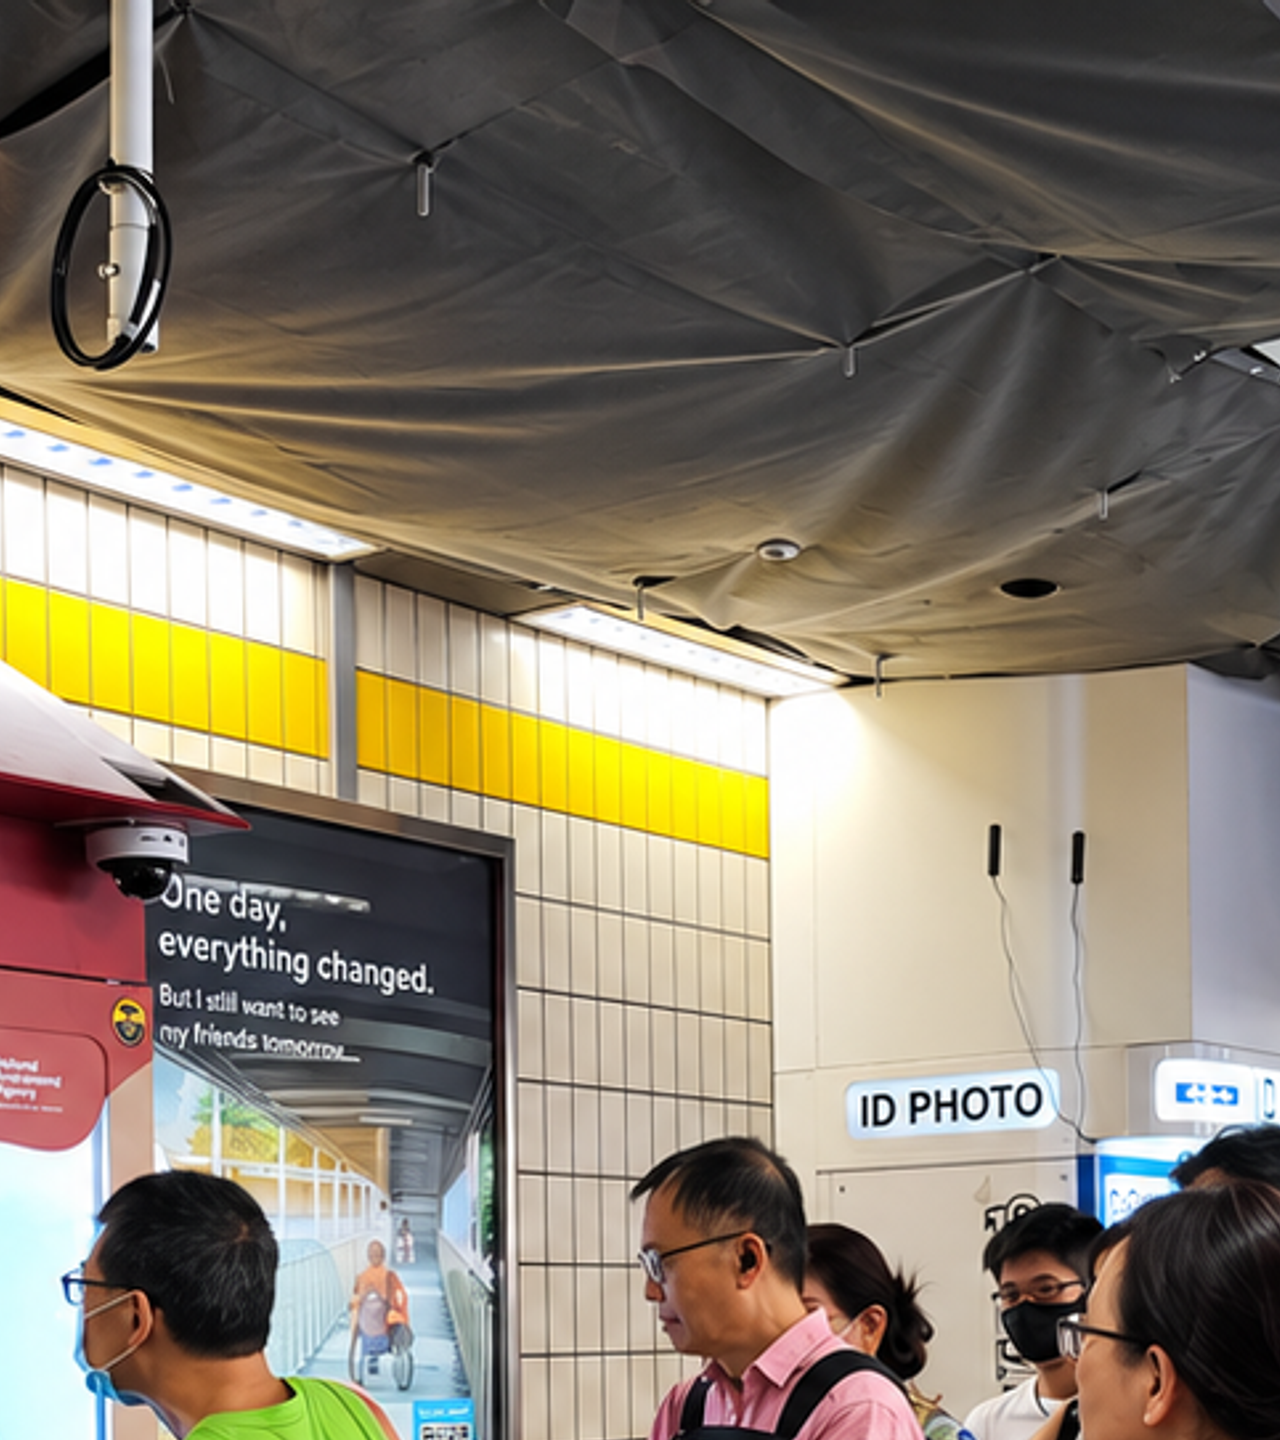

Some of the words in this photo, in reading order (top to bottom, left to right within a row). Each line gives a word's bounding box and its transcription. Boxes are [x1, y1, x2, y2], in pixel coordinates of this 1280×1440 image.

[161, 873, 222, 915] One
[229, 884, 287, 933] day,
[158, 931, 311, 985] everything
[316, 950, 435, 997] changed.
[159, 982, 192, 1009] But
[196, 988, 202, 1009] I
[206, 991, 238, 1013] still
[242, 1000, 285, 1020] want
[288, 1004, 307, 1023] to
[310, 1008, 341, 1027] see
[159, 1025, 190, 1050] my
[194, 1022, 258, 1050] friends
[860, 1093, 896, 1128] ID
[909, 1082, 1043, 1125] PHOTO
